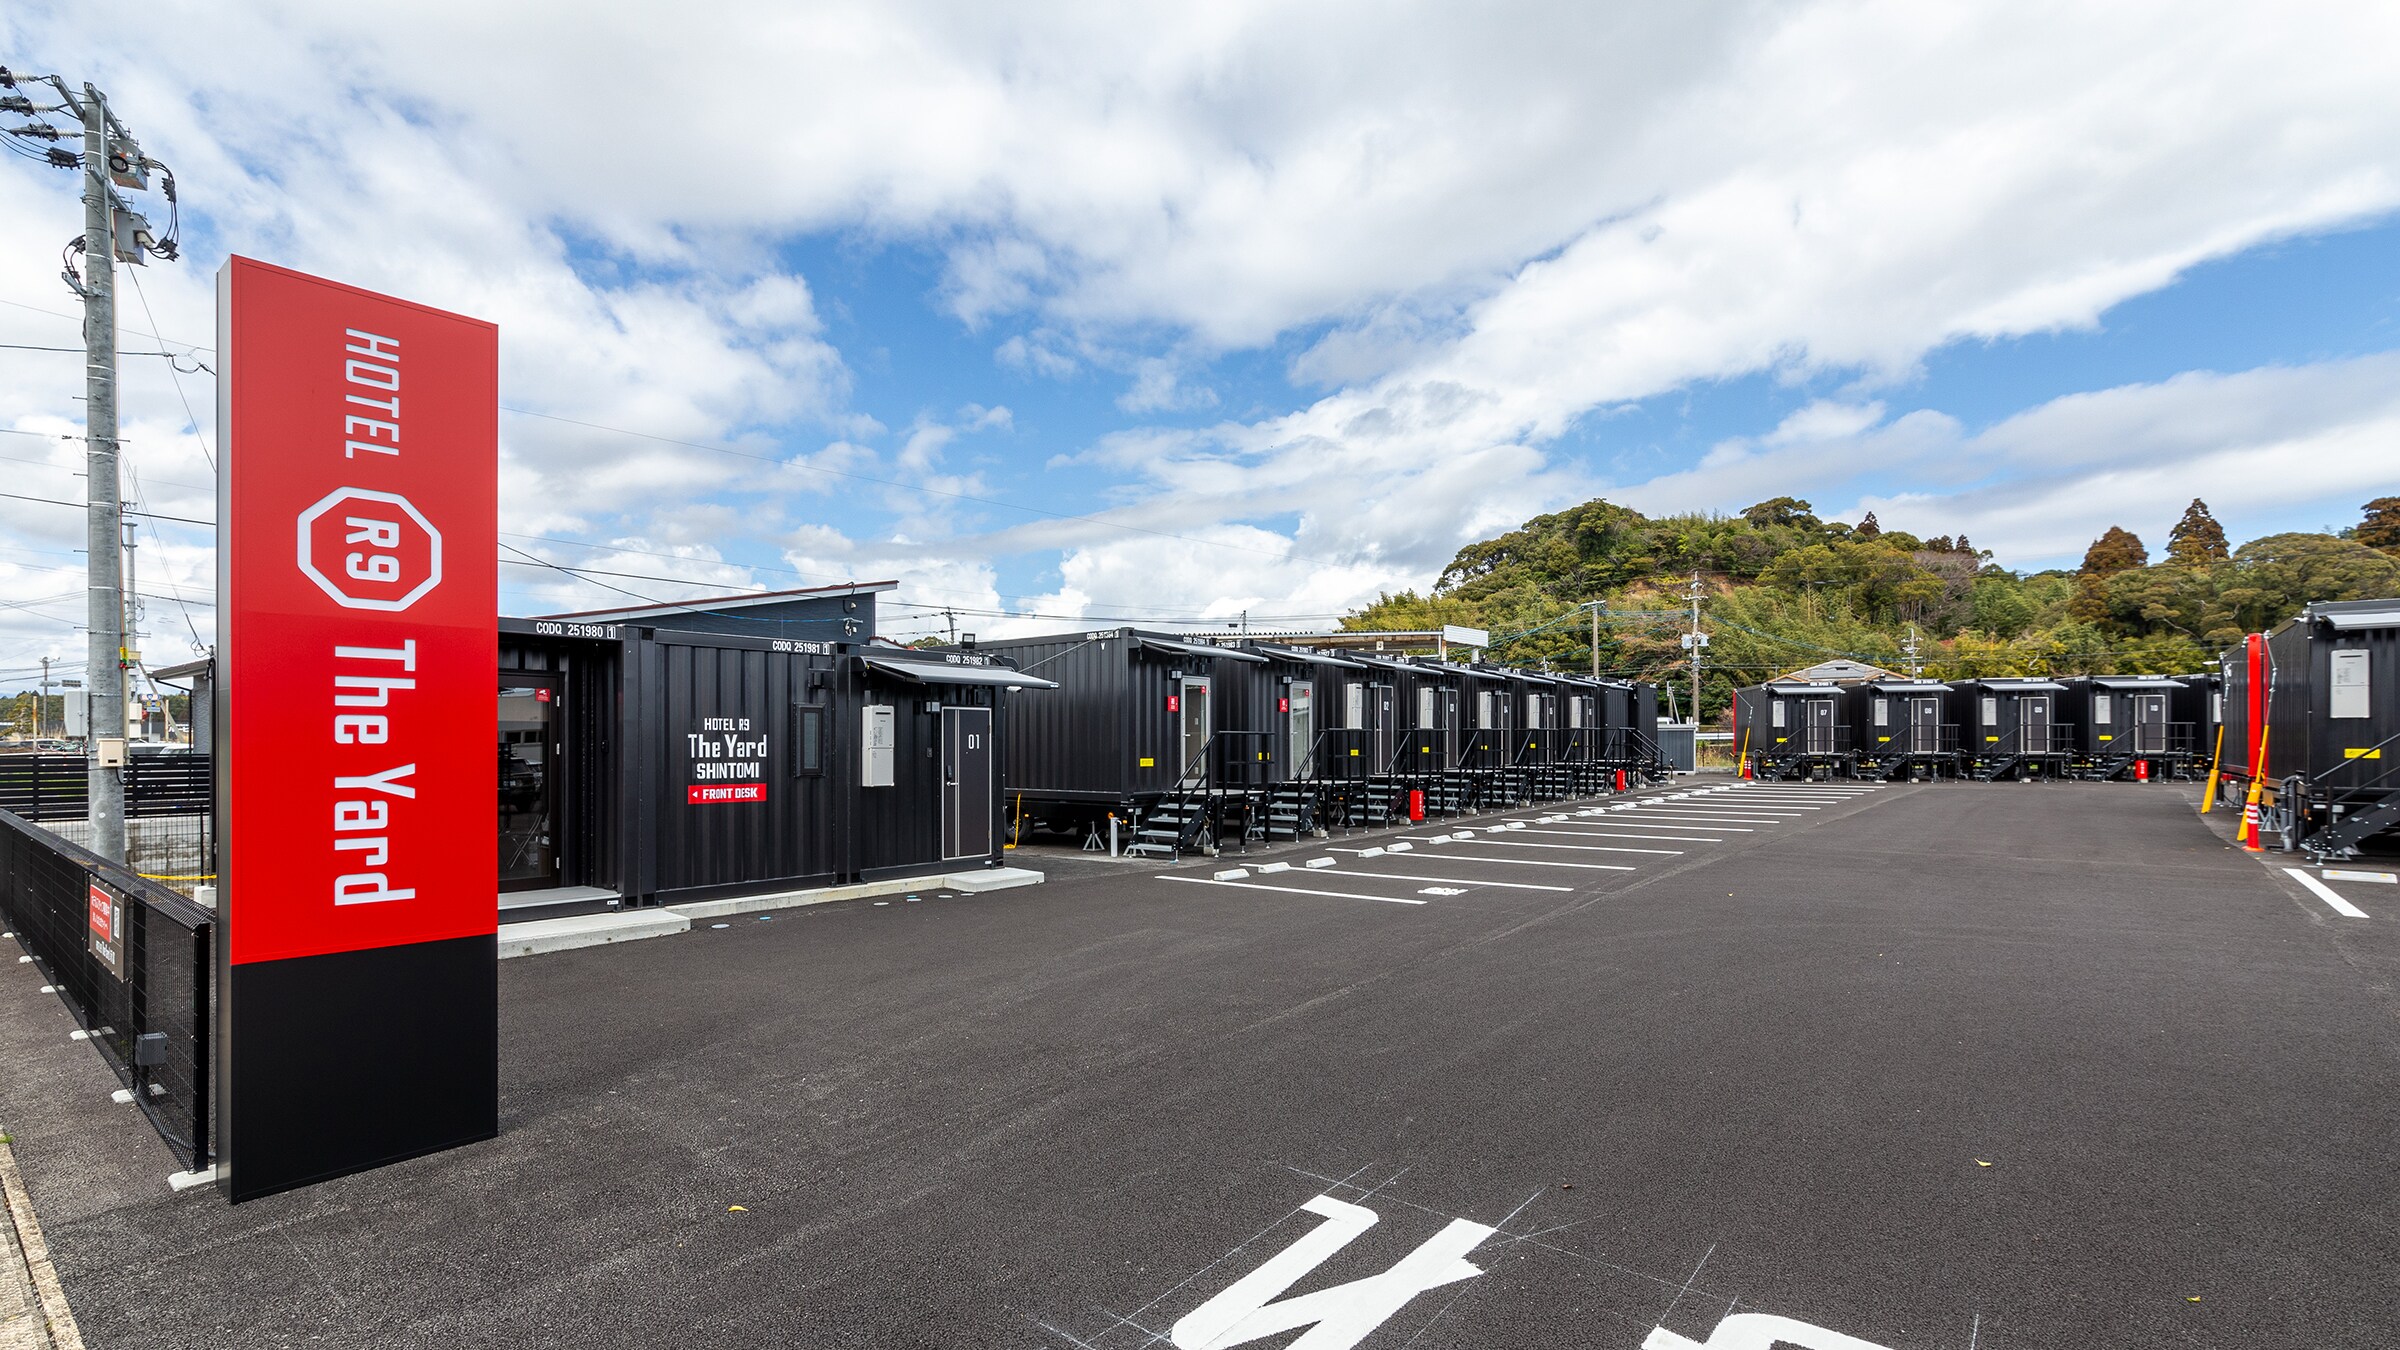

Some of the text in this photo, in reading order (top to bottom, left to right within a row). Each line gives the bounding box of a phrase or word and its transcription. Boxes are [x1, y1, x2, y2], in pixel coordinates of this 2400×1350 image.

[334, 327, 416, 906] HOTEL R9 The Yard
[536, 621, 562, 635] CODQ
[567, 624, 603, 638] 251980
[772, 640, 791, 652] CODQ
[794, 642, 820, 654] 251981
[704, 717, 750, 731] HOTEL R9
[687, 733, 767, 758] The Yard
[968, 734, 980, 749] 01
[696, 762, 760, 780] SHINTOMI
[702, 787, 758, 800] FRONT DESK
